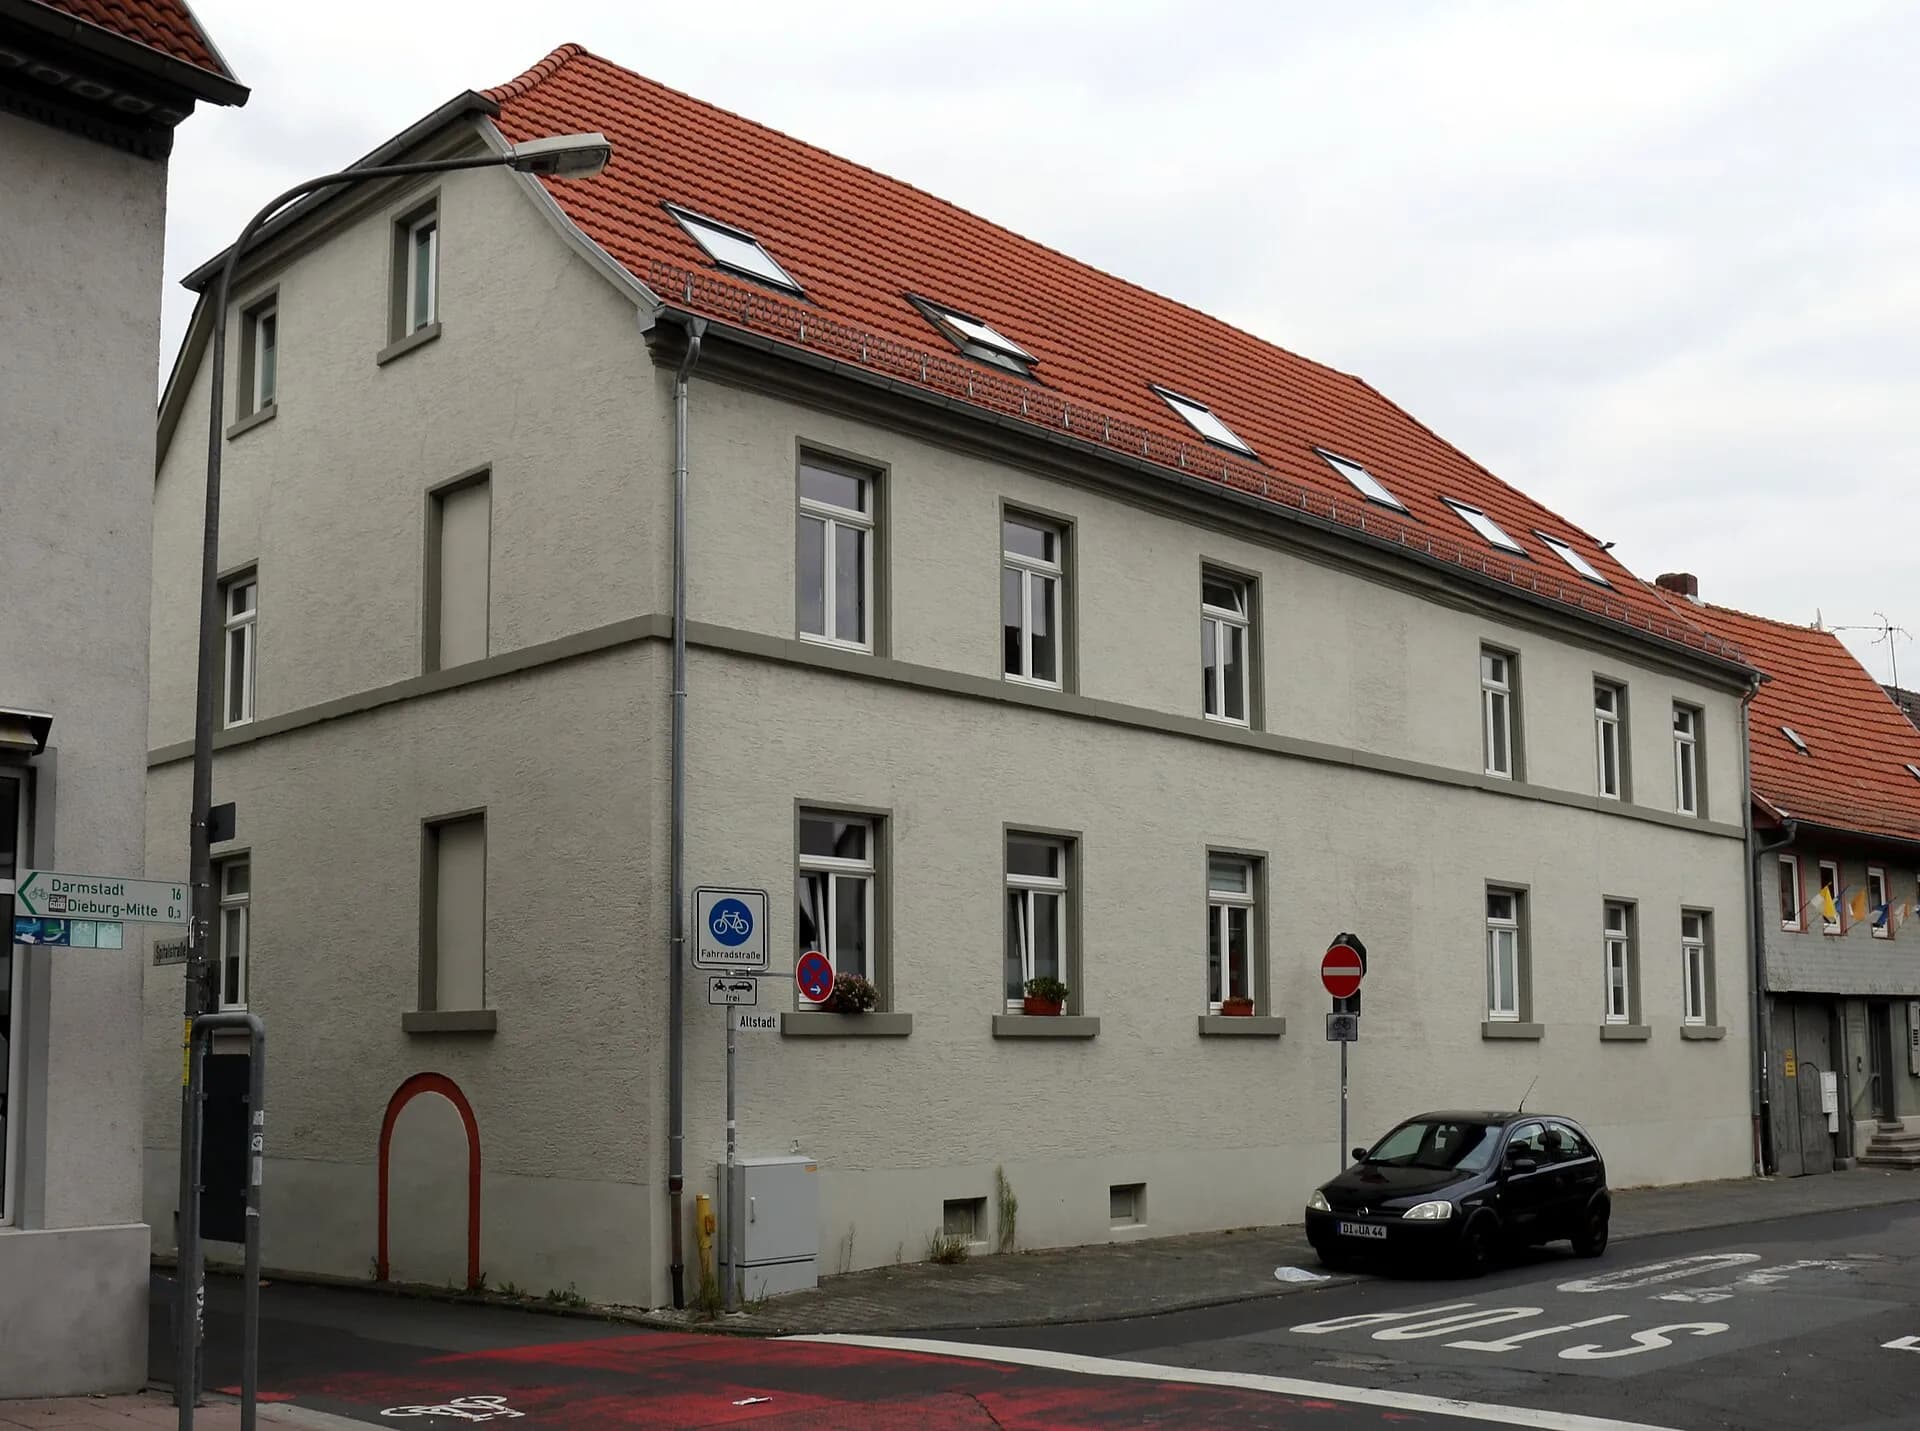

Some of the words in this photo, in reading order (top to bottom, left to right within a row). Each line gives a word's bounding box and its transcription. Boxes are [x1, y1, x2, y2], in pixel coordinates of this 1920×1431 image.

[51, 879, 124, 897] Darmstadt
[172, 887, 181, 901] 16
[68, 899, 158, 918] Dieburg-Mitte
[701, 949, 761, 960] Fahrradstraße
[725, 993, 740, 1002] frei
[740, 1016, 776, 1028] Altstadt
[1372, 1226, 1383, 1237] 44
[1289, 1302, 1731, 1360] STOP
